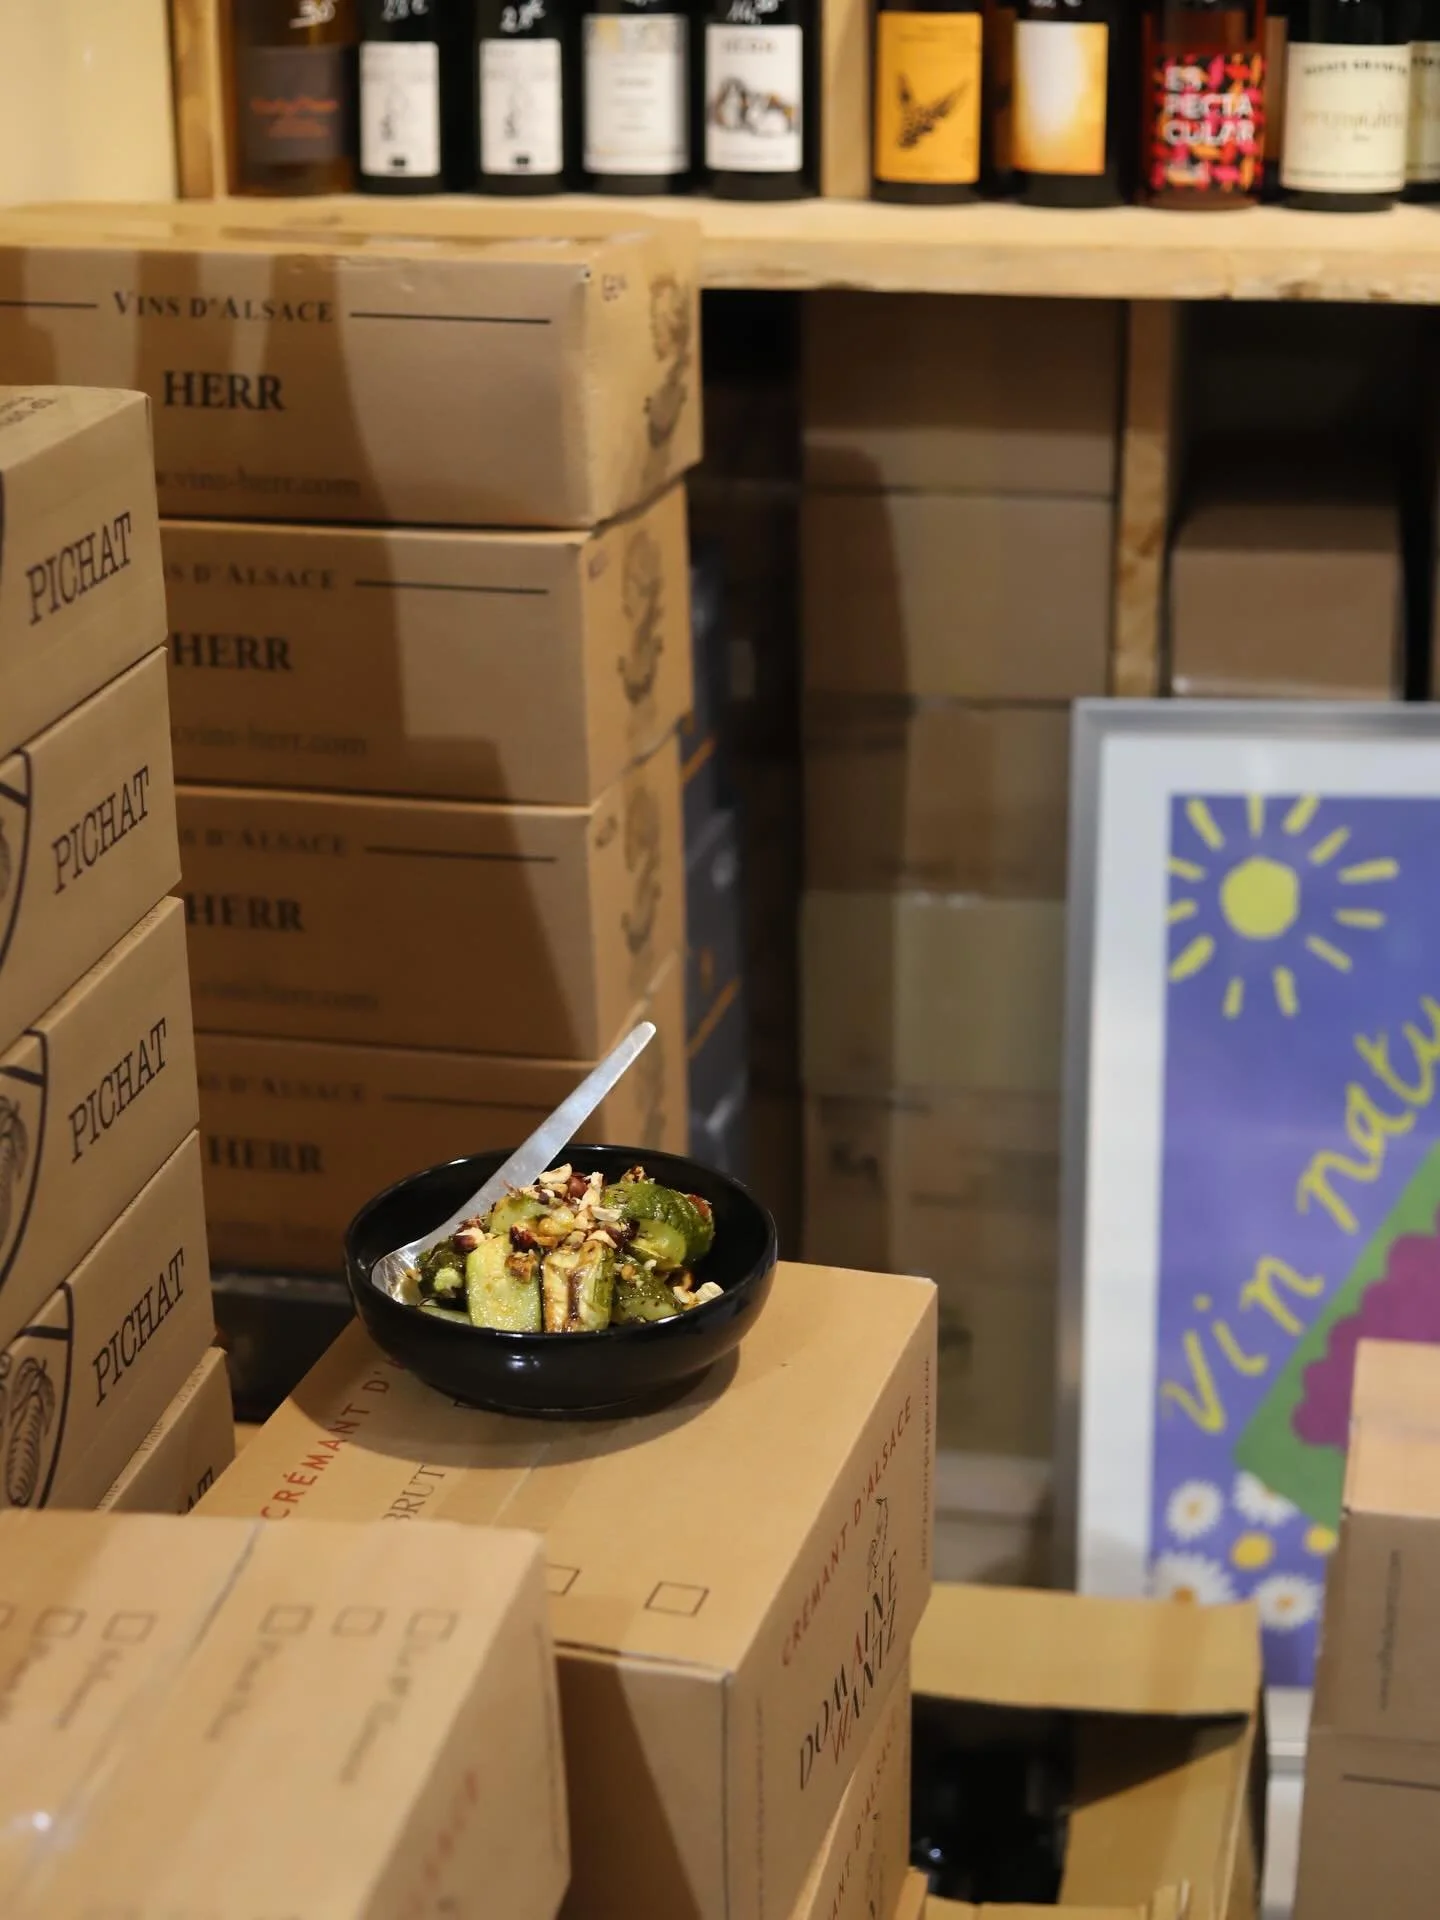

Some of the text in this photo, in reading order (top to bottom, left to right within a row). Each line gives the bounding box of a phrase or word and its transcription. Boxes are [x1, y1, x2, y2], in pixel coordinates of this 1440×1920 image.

[112, 289, 183, 319] VINS
[163, 369, 288, 412] HERR
[25, 510, 132, 626] PICHAT
[172, 631, 294, 672] HERR
[51, 765, 150, 896] PICHAT
[185, 892, 305, 932] HERR
[68, 1016, 167, 1165] PICHAT
[207, 1135, 327, 1174] HERR
[92, 1246, 186, 1408] PICHAT
[1160, 1253, 1326, 1435] Vin
[260, 1402, 372, 1520] CRÉMANT
